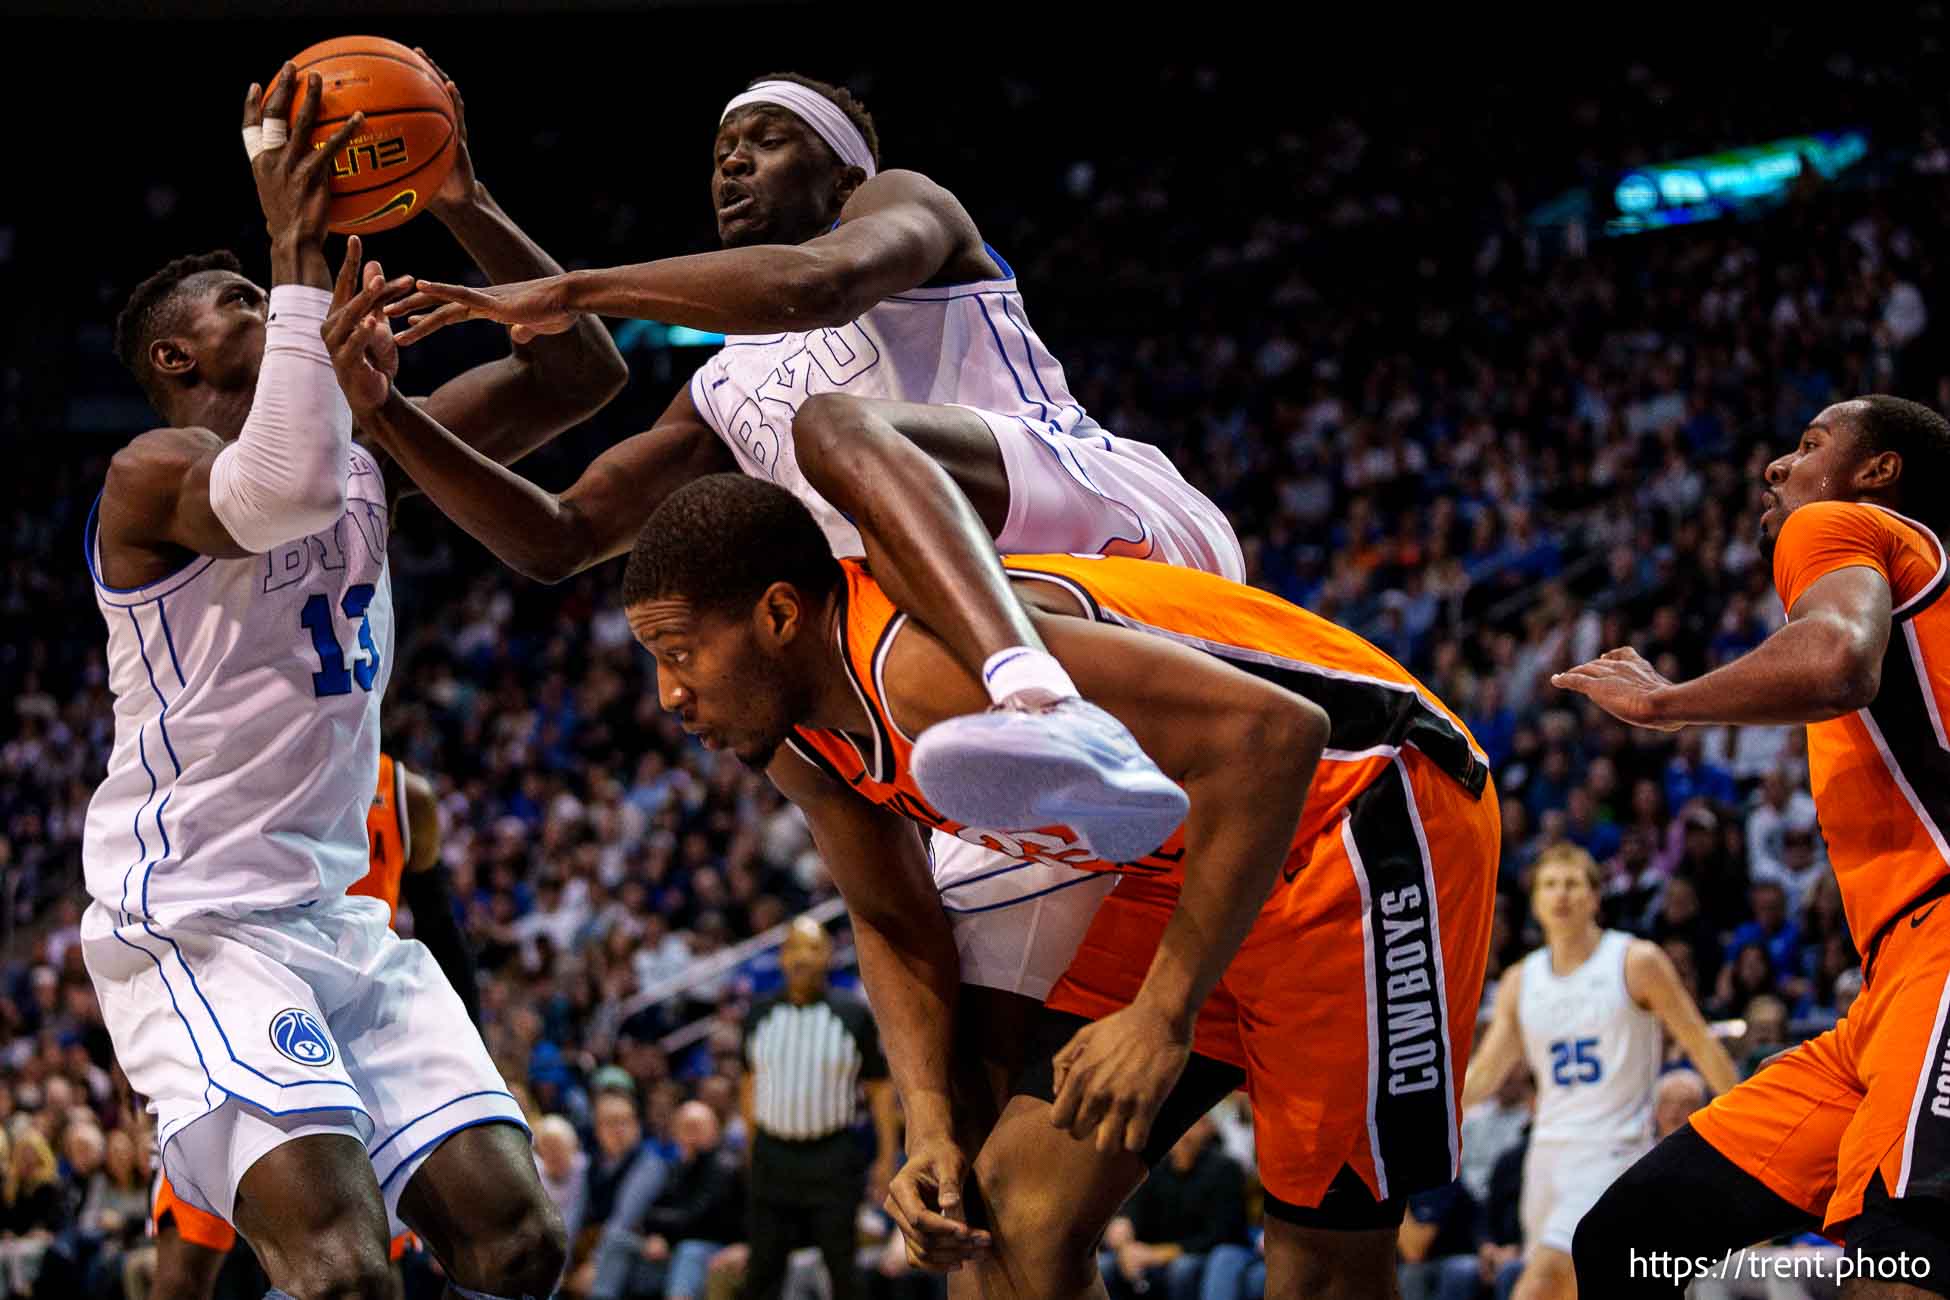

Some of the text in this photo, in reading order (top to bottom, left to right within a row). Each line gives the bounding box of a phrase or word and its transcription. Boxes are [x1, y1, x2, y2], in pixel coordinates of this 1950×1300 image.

[727, 319, 880, 481] BYU
[301, 583, 380, 697] 13
[1380, 884, 1439, 1096] COWBOYS
[1550, 1040, 1602, 1086] 25
